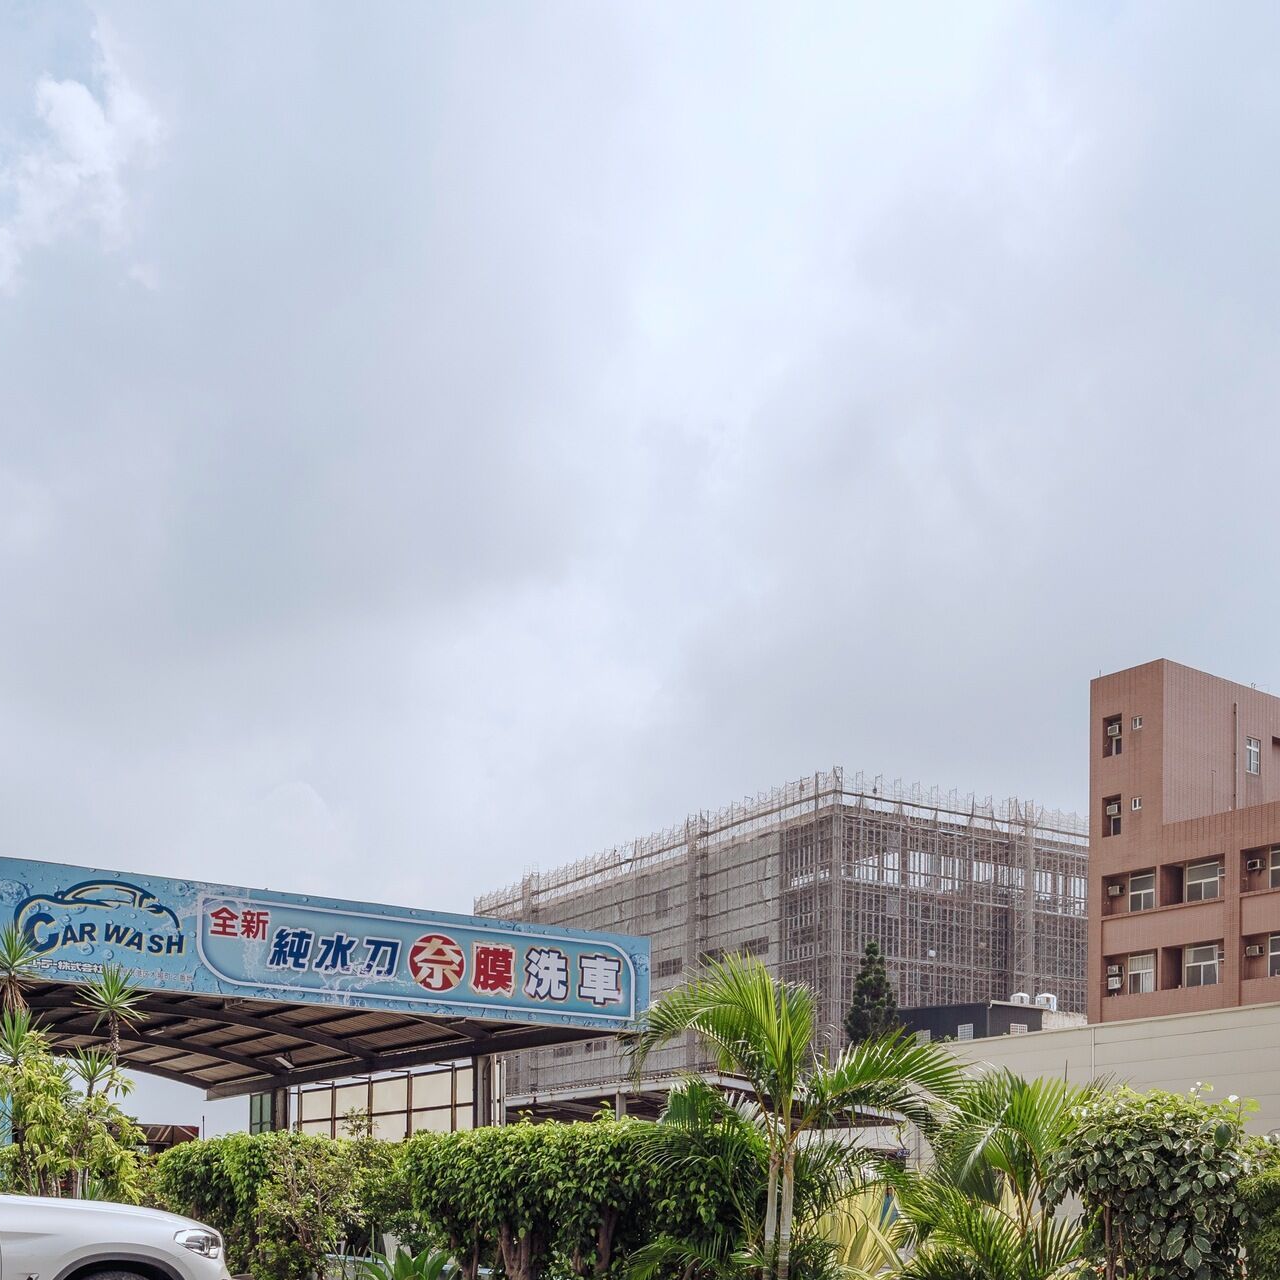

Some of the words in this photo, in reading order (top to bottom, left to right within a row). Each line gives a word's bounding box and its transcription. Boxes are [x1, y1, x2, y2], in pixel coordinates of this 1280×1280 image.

[23, 912, 97, 953] CAR
[104, 922, 184, 954] WASH
[209, 906, 270, 941] 全新
